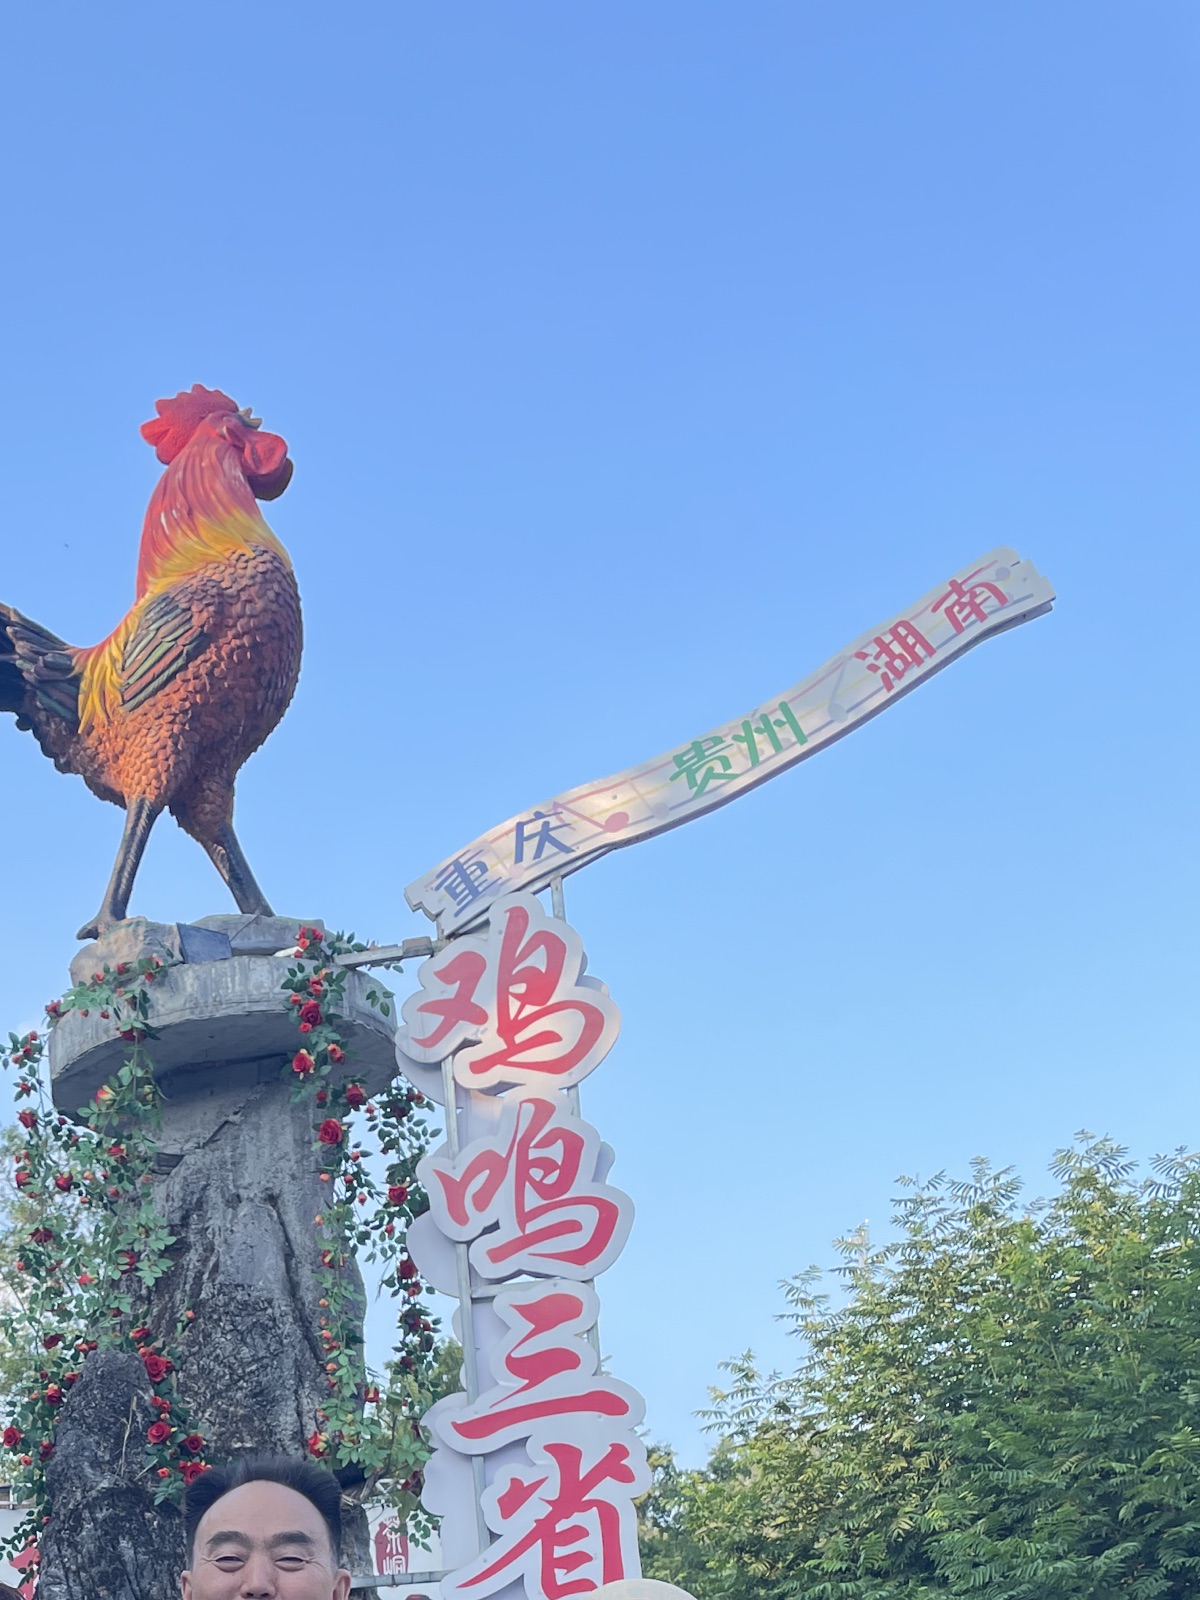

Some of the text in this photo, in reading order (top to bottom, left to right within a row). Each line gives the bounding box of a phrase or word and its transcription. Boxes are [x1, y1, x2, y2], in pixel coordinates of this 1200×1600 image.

[434, 577, 1009, 917] 重庆 贵州 湖南
[411, 905, 635, 1600] 鸡鸣三省
